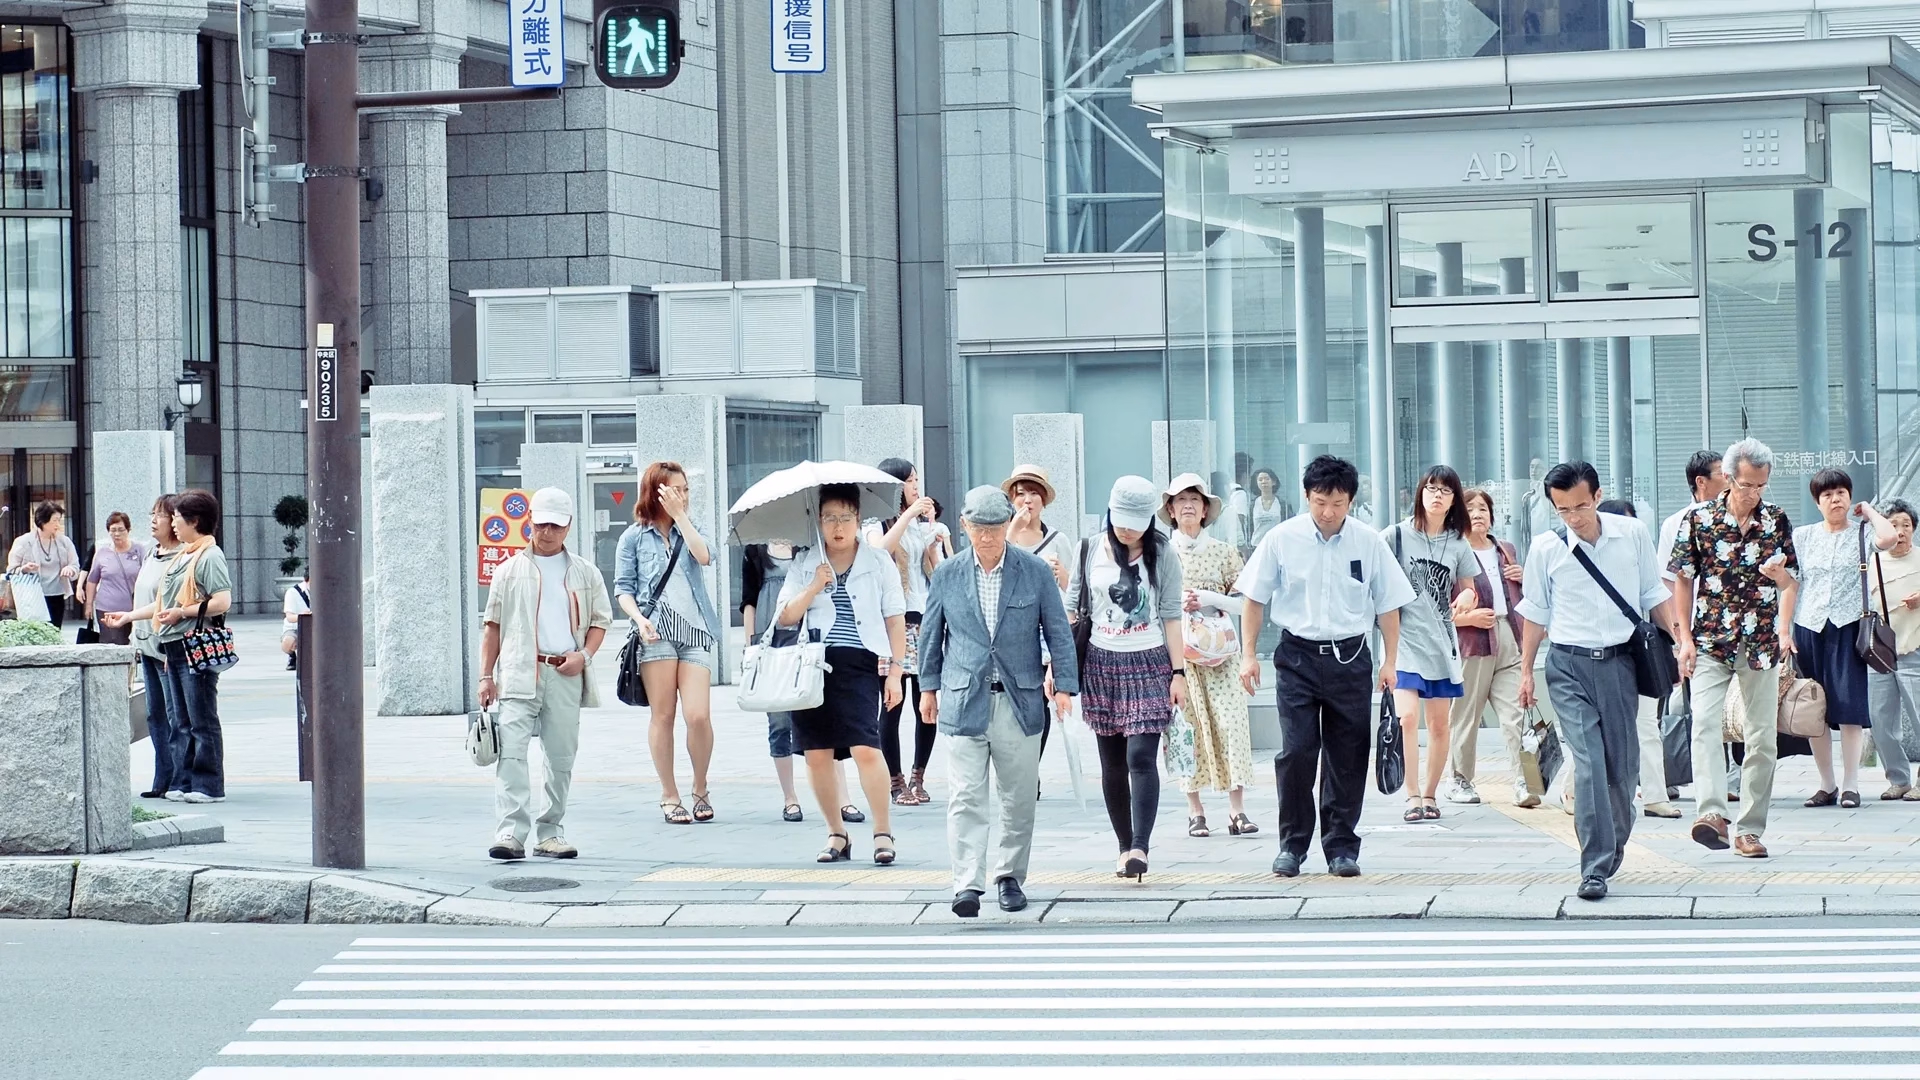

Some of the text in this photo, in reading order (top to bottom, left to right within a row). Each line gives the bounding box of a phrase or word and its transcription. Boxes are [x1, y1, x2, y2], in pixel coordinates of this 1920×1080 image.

[783, 0, 812, 62] 援信号
[1747, 221, 1853, 261] S-12
[321, 360, 331, 417] 90235
[483, 547, 522, 561] 進入
